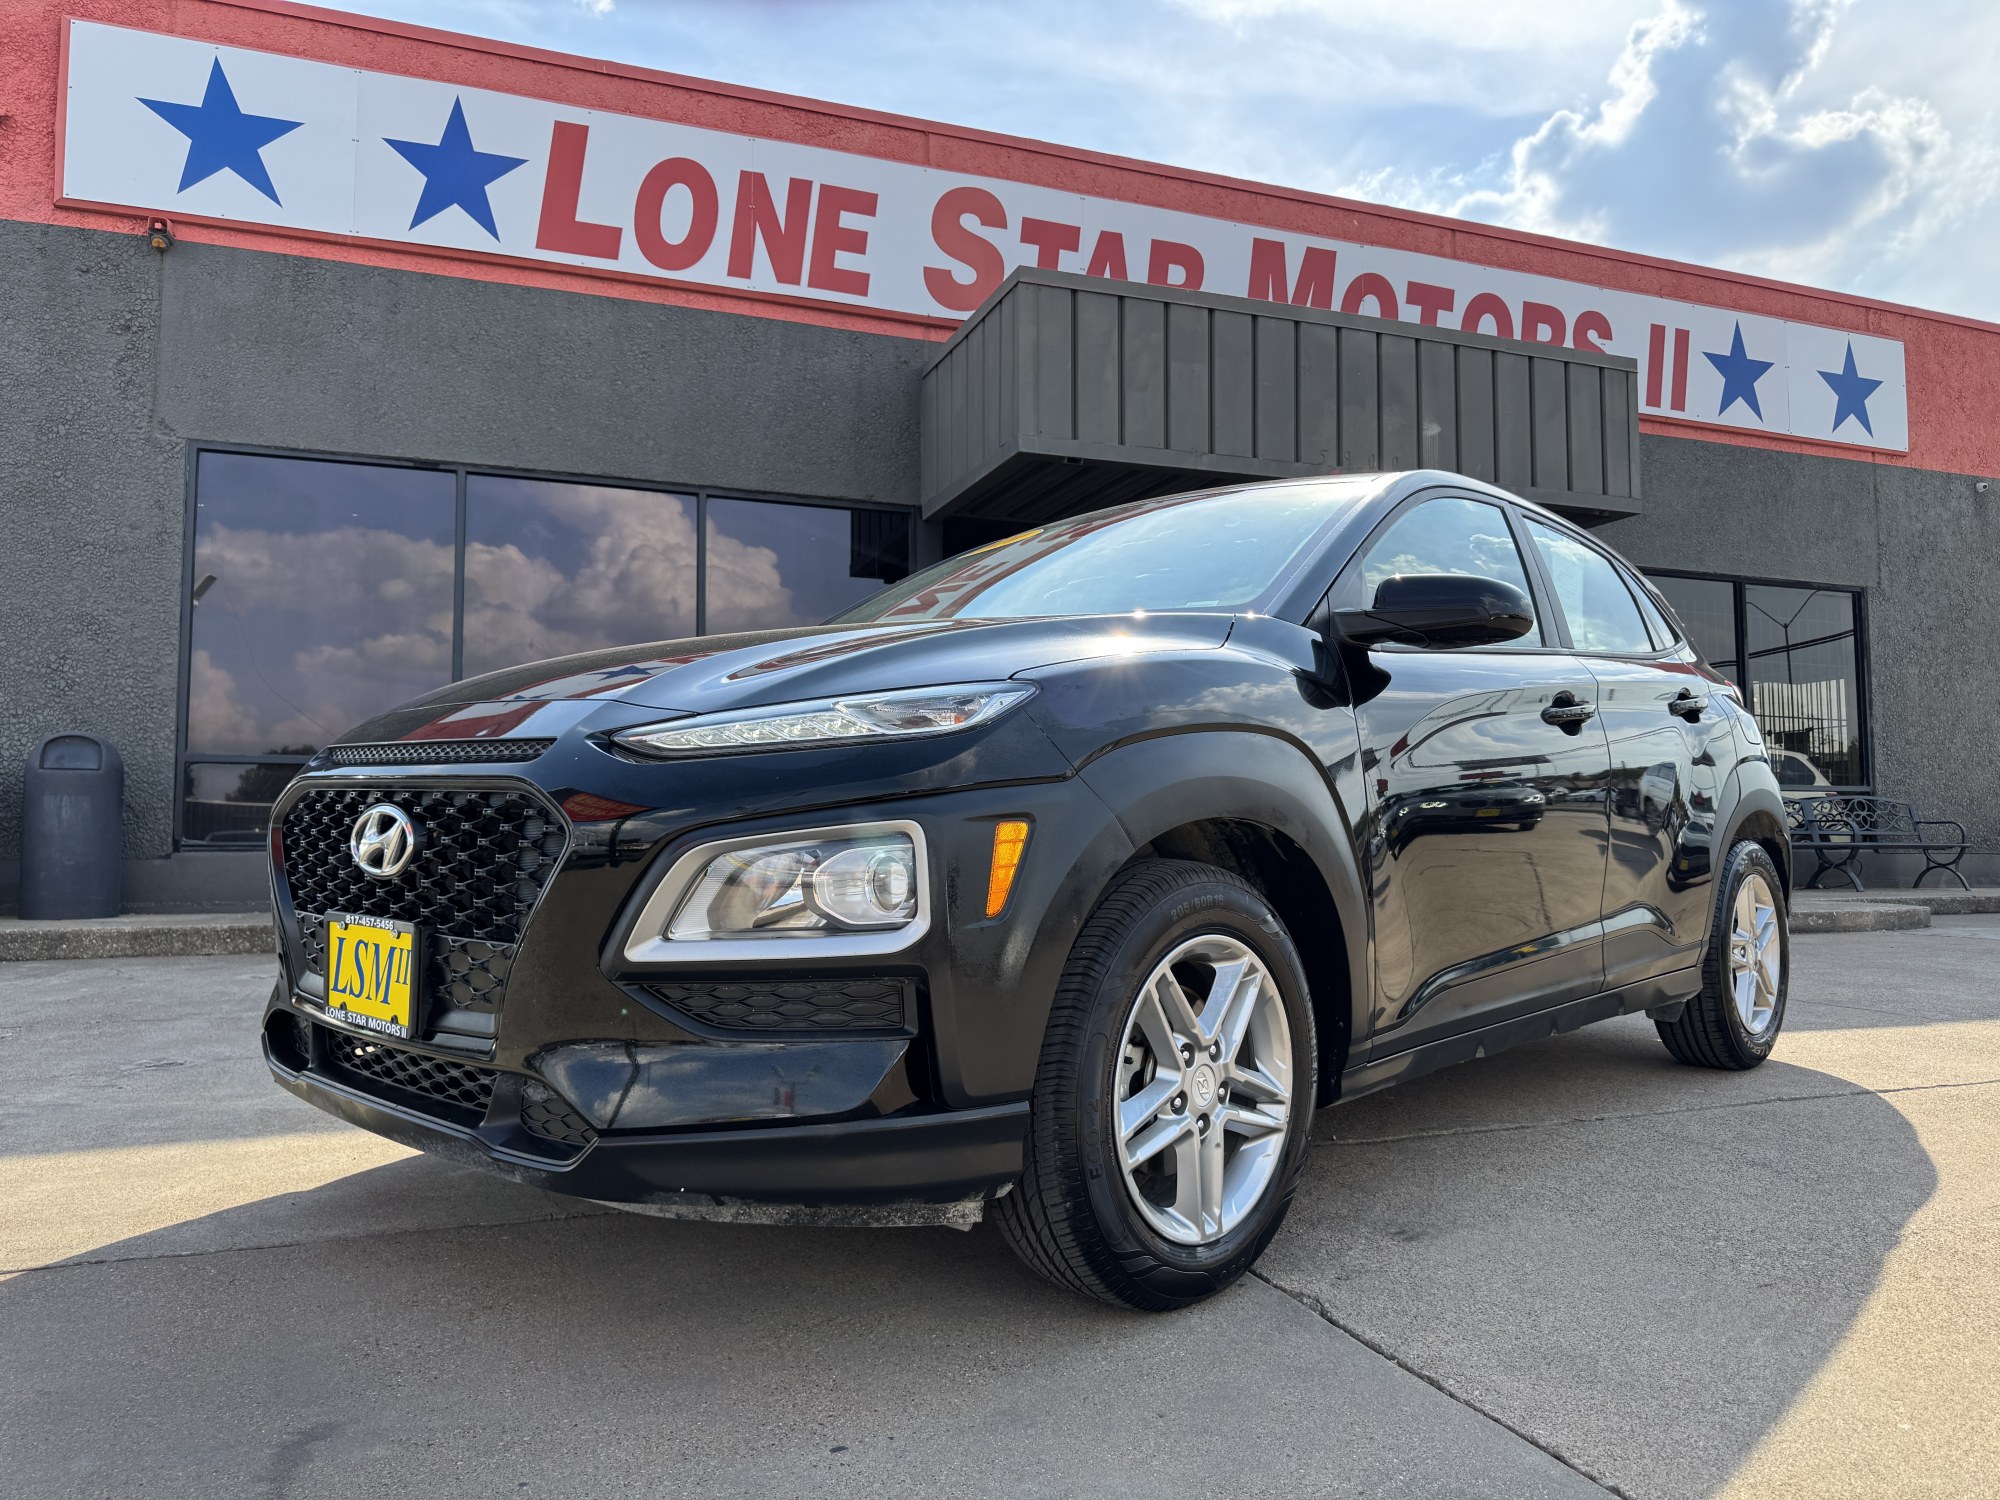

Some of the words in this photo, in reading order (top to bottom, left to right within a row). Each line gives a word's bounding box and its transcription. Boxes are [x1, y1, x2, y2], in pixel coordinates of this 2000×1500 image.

[535, 120, 878, 297] LONE
[923, 187, 1205, 312] STAR
[1646, 323, 1690, 412] II
[345, 915, 394, 930] 817-457-5456
[325, 1006, 346, 1021] LONE
[347, 1012, 367, 1027] STAR
[368, 1017, 401, 1037] MOTORS
